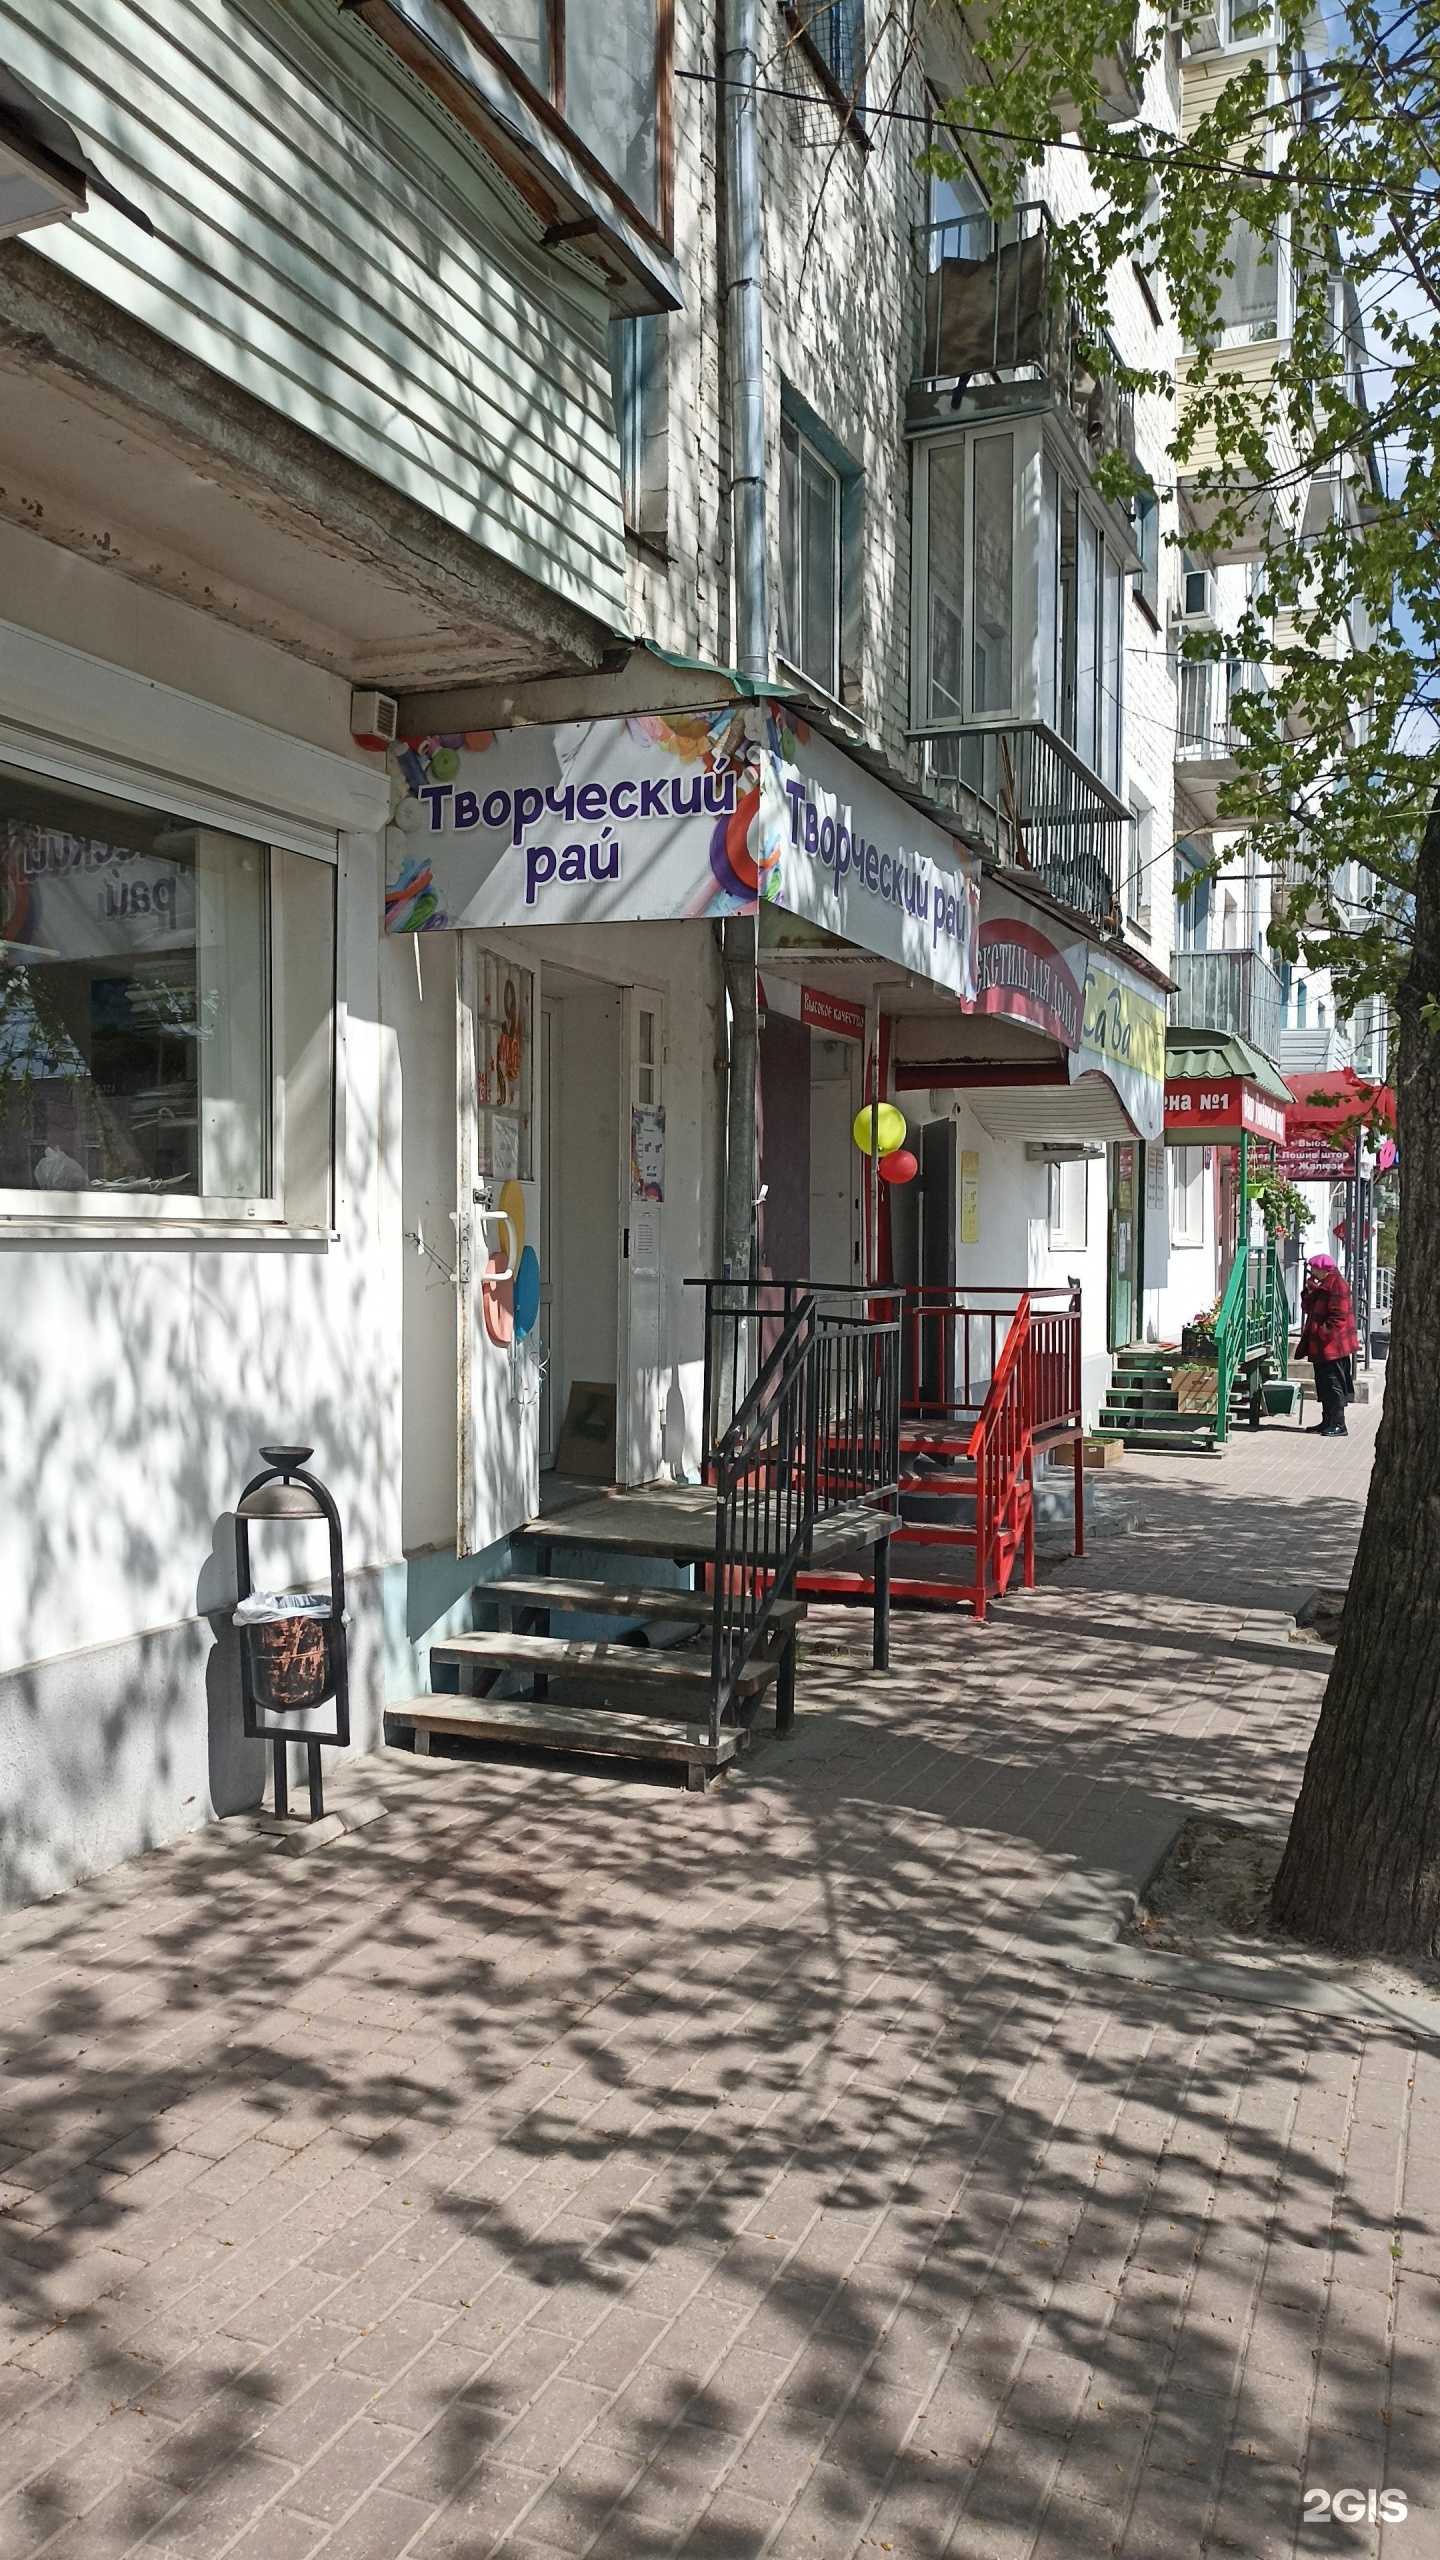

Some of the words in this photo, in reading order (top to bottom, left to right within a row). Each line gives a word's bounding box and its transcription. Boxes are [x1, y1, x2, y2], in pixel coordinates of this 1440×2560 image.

[419, 756, 736, 845] Творческий
[525, 827, 620, 904] рай
[786, 779, 929, 920] Творческий
[933, 886, 966, 949] рай
[976, 944, 1029, 993] ЕКСТИЛЬ
[1200, 1093, 1229, 1110] №1
[1298, 1139, 1331, 1148] Выез
